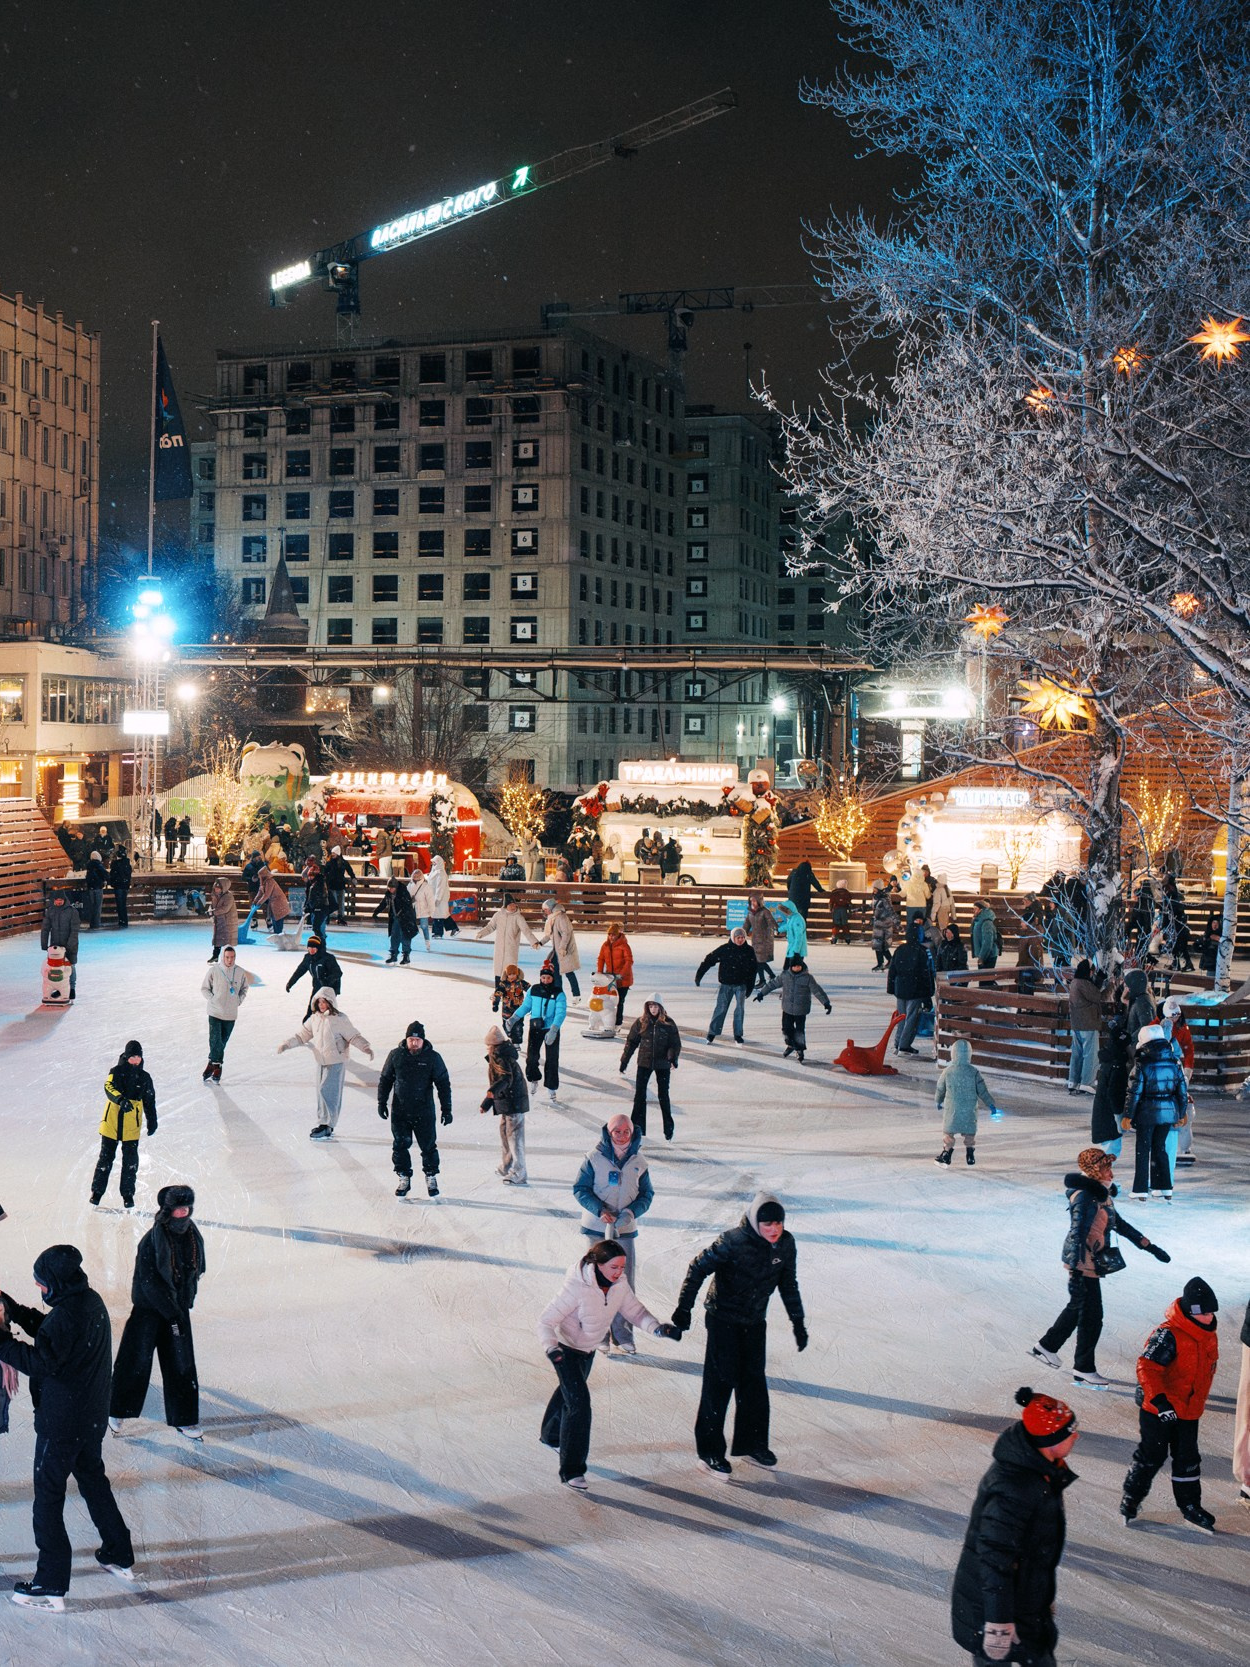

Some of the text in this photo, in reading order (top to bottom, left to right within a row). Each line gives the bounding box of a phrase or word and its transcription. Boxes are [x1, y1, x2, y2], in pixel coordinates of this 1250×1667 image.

[371, 181, 497, 248] ВАСИЛЬЕВСКОГО
[522, 579, 527, 587] 5
[954, 791, 1025, 805] БАТИСКАФ
